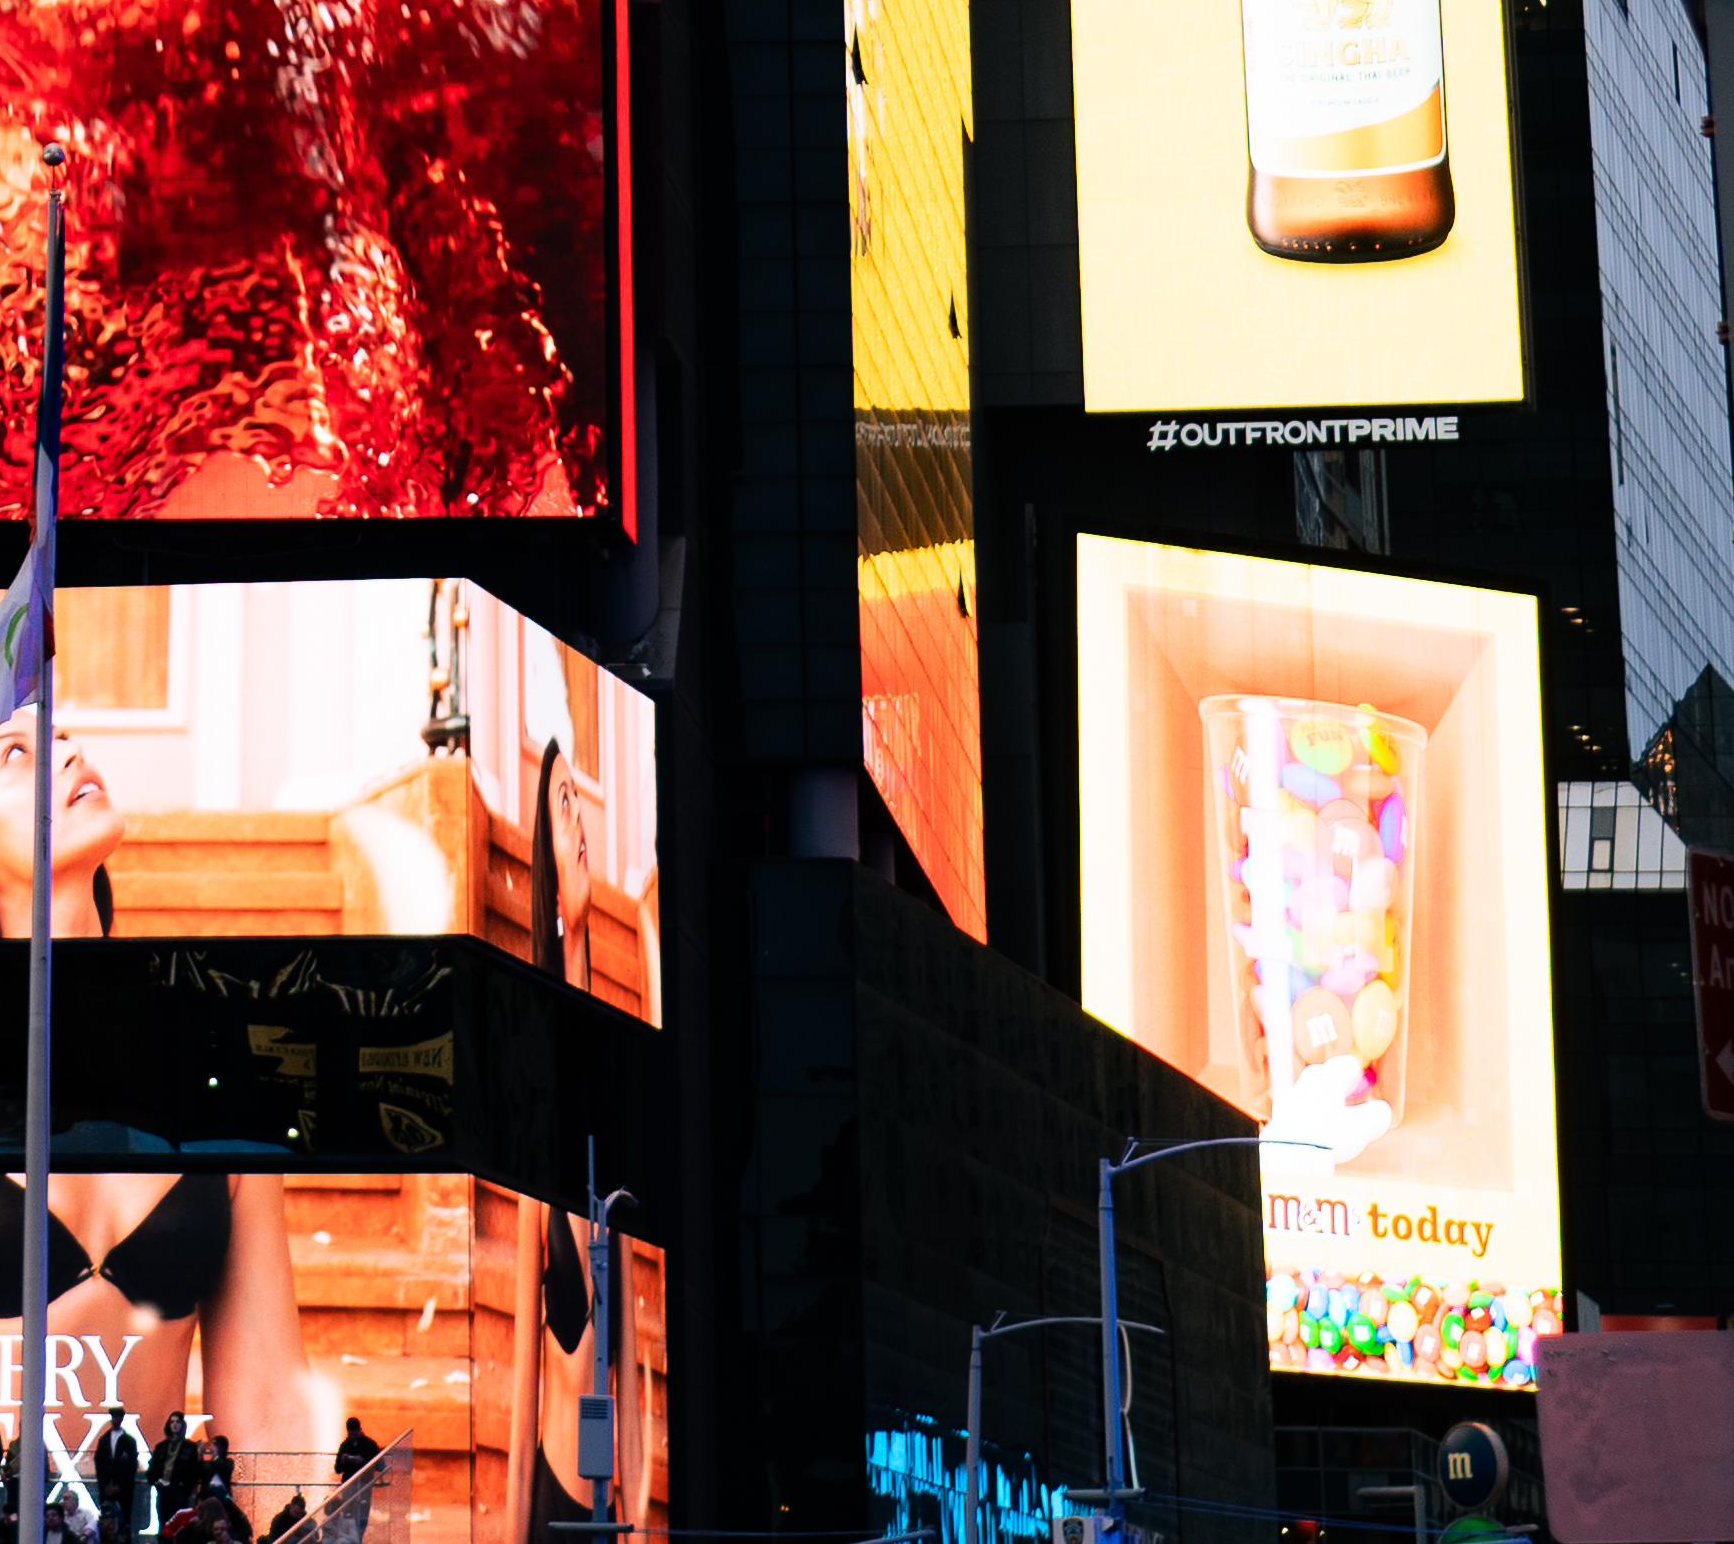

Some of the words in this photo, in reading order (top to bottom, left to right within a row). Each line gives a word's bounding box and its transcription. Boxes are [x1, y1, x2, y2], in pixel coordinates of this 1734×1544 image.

[1277, 34, 1411, 68] SINGHA
[1145, 416, 1460, 452] #OUTFRONTPRIME
[1367, 1202, 1495, 1258] today
